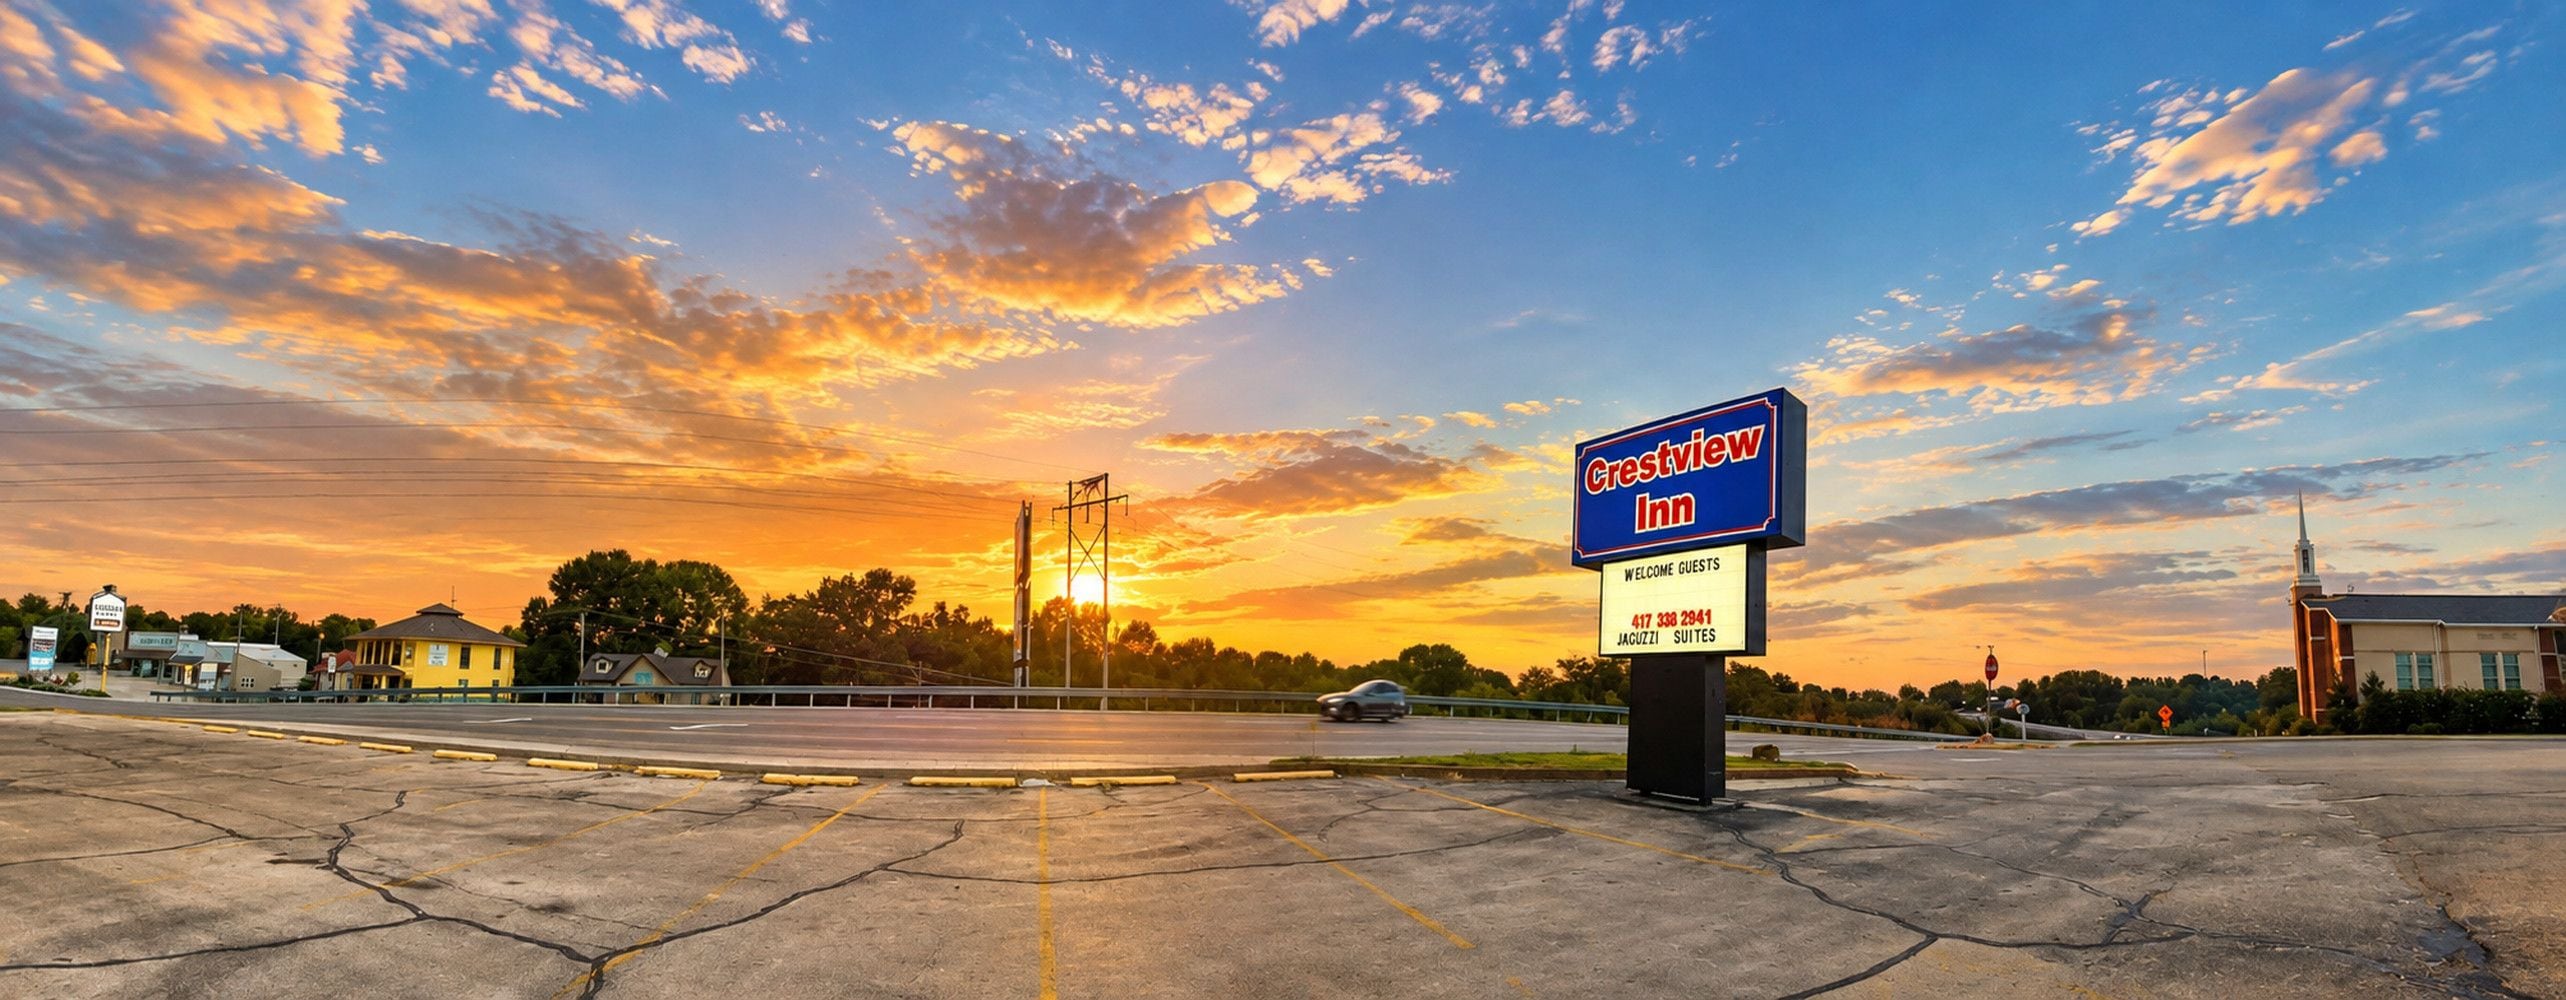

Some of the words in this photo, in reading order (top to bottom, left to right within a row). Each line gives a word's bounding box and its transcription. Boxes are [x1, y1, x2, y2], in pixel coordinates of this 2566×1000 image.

[1586, 425, 1765, 494] Crestview
[1635, 492, 1695, 533] Inn
[1625, 562, 1674, 582] WELCOME
[1679, 557, 1720, 575] GUESTS
[1631, 613, 1653, 629] 417
[1681, 609, 1712, 626] 2941
[1674, 628, 1716, 644] SUITES
